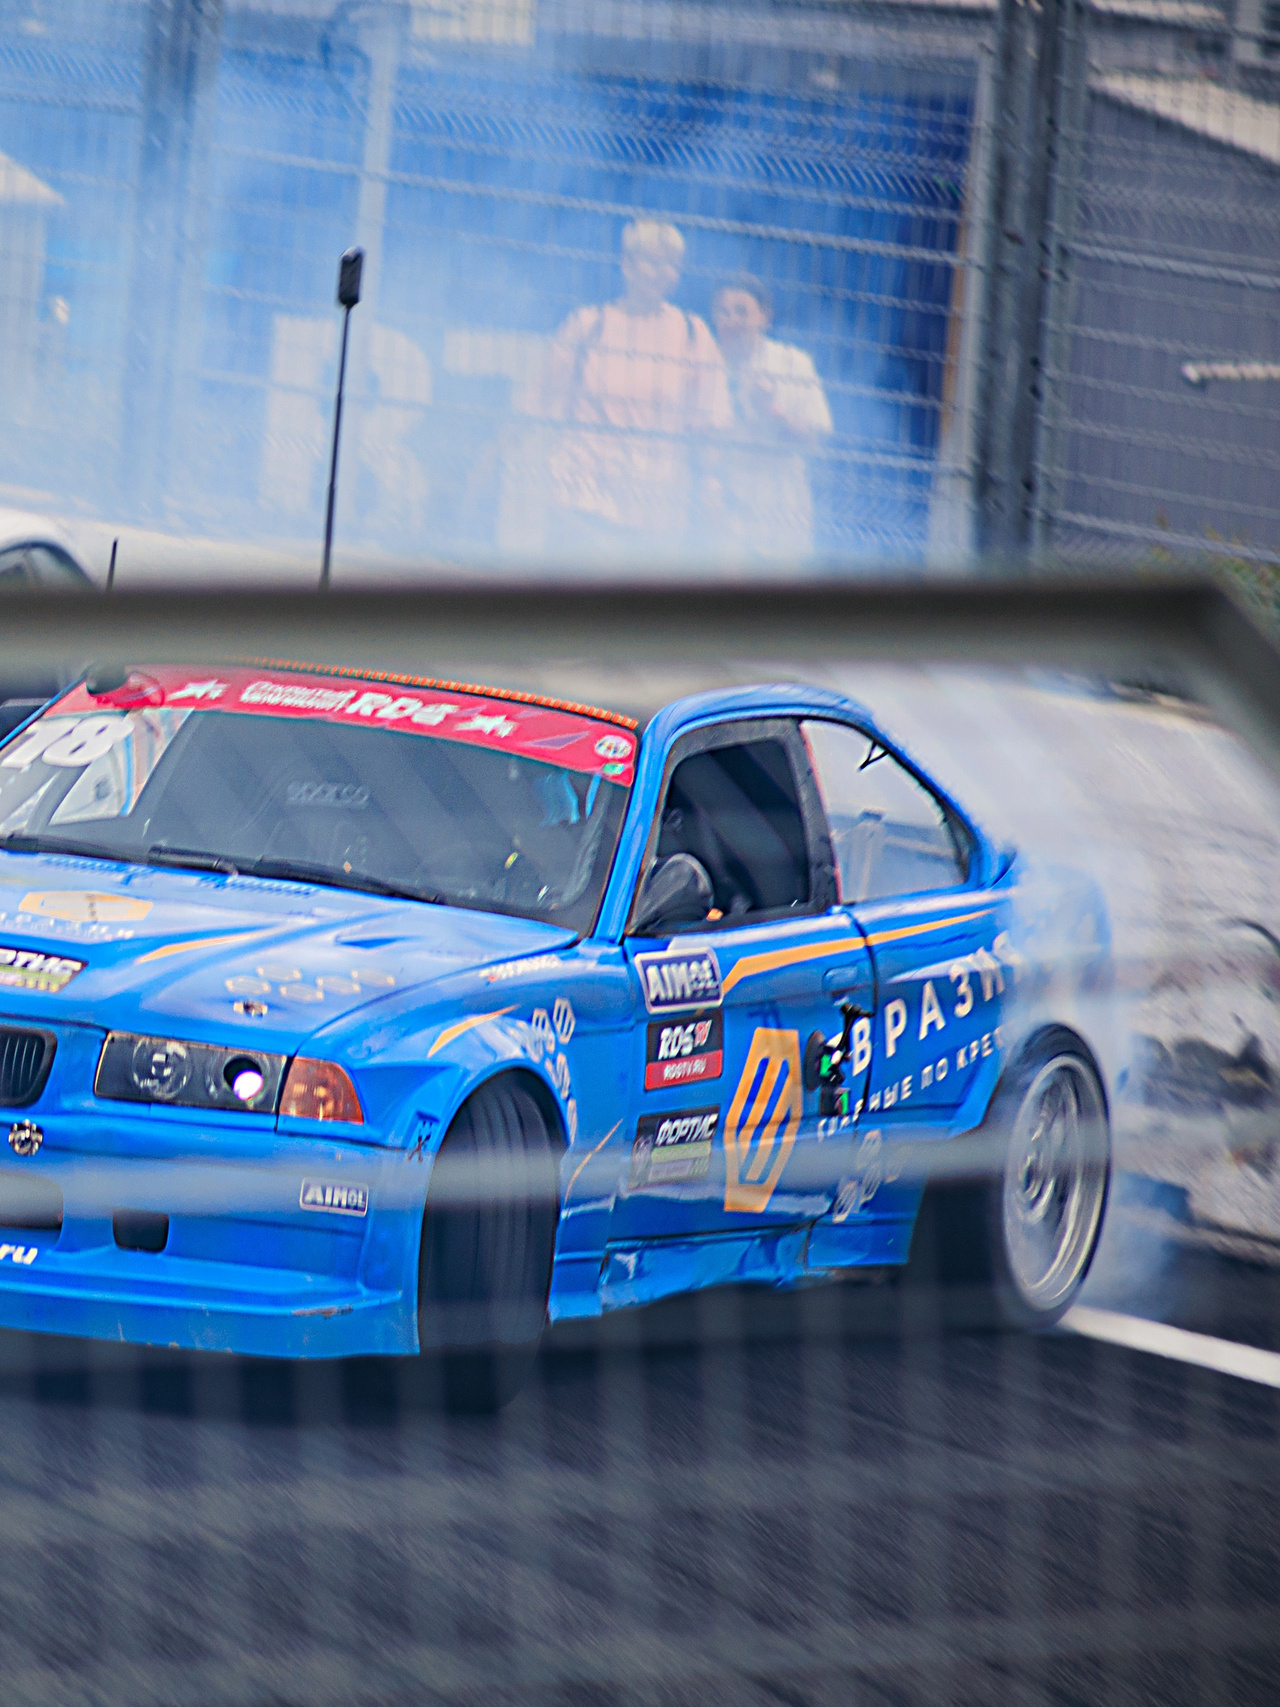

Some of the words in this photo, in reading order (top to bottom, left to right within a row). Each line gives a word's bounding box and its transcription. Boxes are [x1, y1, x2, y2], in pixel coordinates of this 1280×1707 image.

[0, 715, 136, 768] 18
[655, 1113, 718, 1146] ФОРТИС
[304, 1185, 365, 1208] AIMOL
